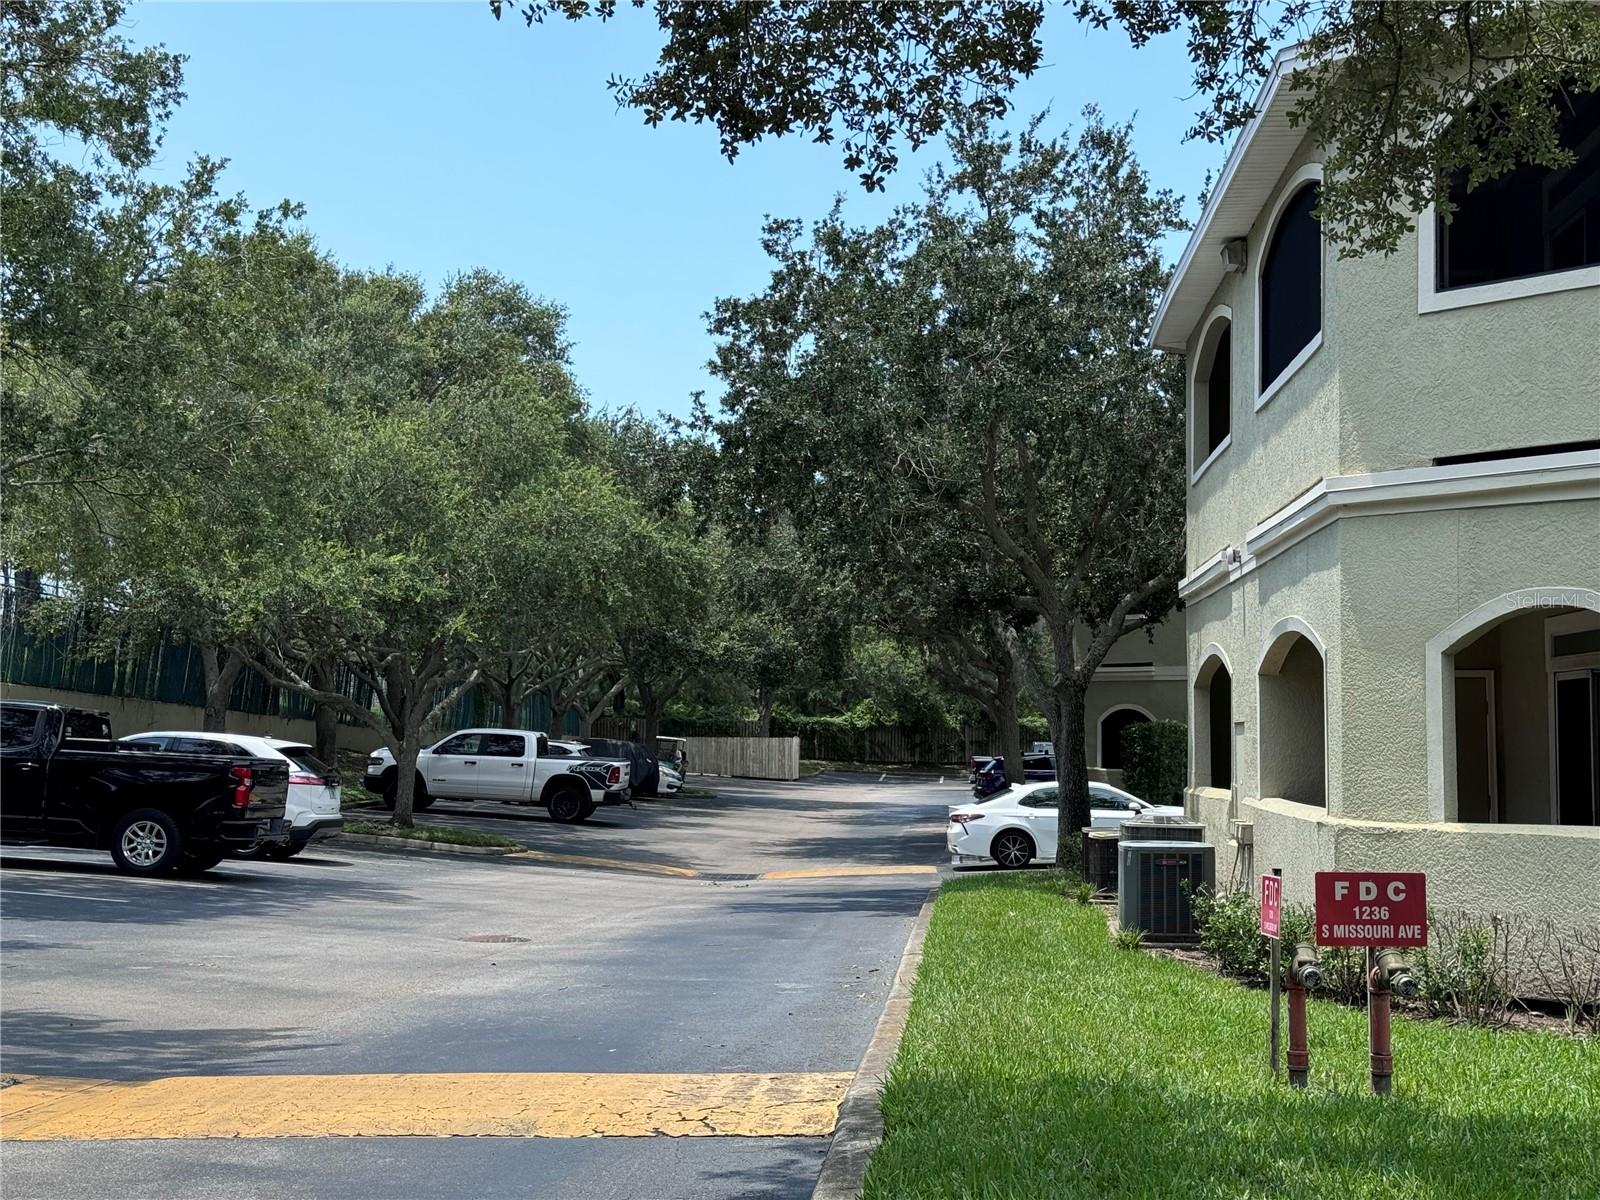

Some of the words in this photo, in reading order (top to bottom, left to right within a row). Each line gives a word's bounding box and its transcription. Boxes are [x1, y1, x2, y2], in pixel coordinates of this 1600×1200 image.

[1353, 905, 1390, 920] 1236
[1322, 924, 1330, 938] S
[1333, 924, 1394, 938] MISSOURI
[1398, 925, 1422, 939] AVE
